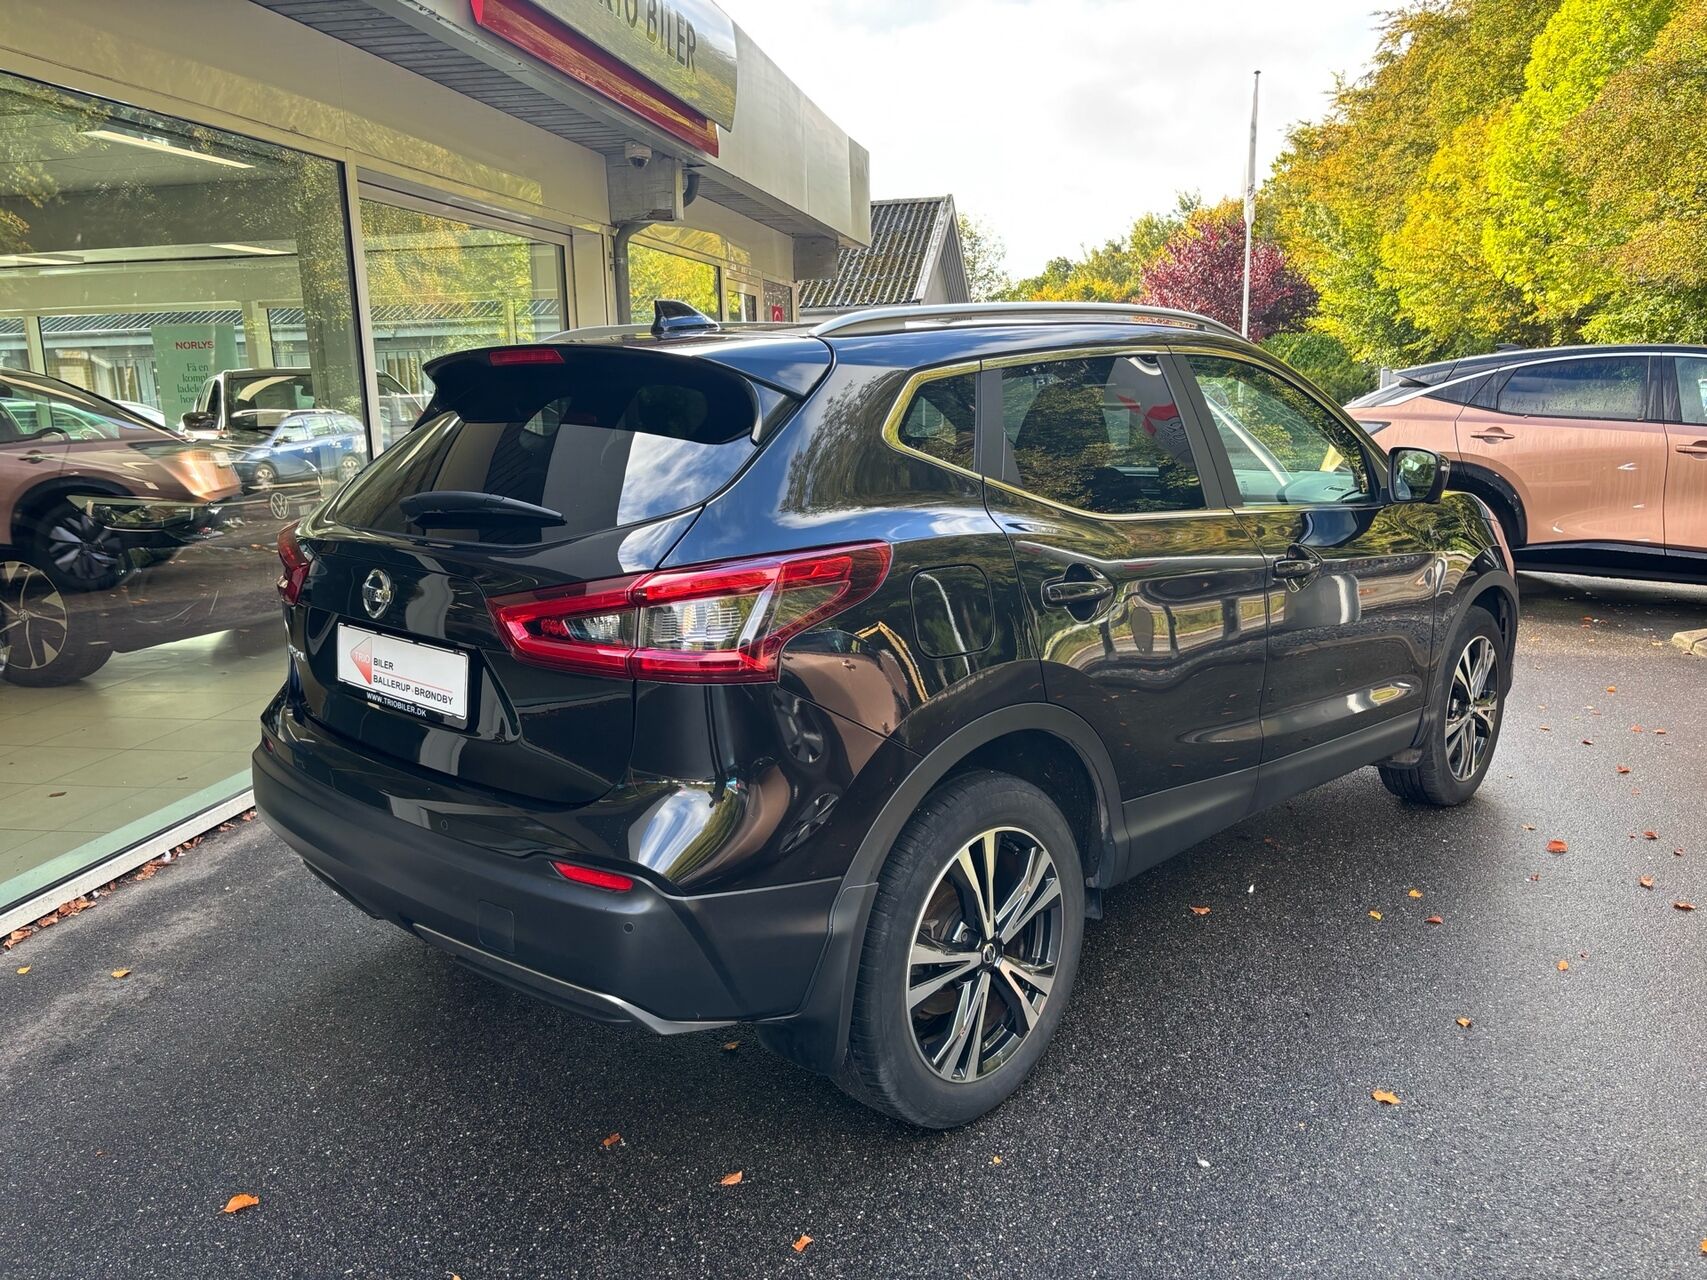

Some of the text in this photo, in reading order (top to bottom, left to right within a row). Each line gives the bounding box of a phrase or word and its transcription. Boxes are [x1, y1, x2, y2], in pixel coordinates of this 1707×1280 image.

[647, 0, 697, 73] BILER
[175, 340, 214, 350] NORLYS
[373, 657, 394, 671] BILER
[366, 692, 427, 717] WWW.TRIOBILER.DK
